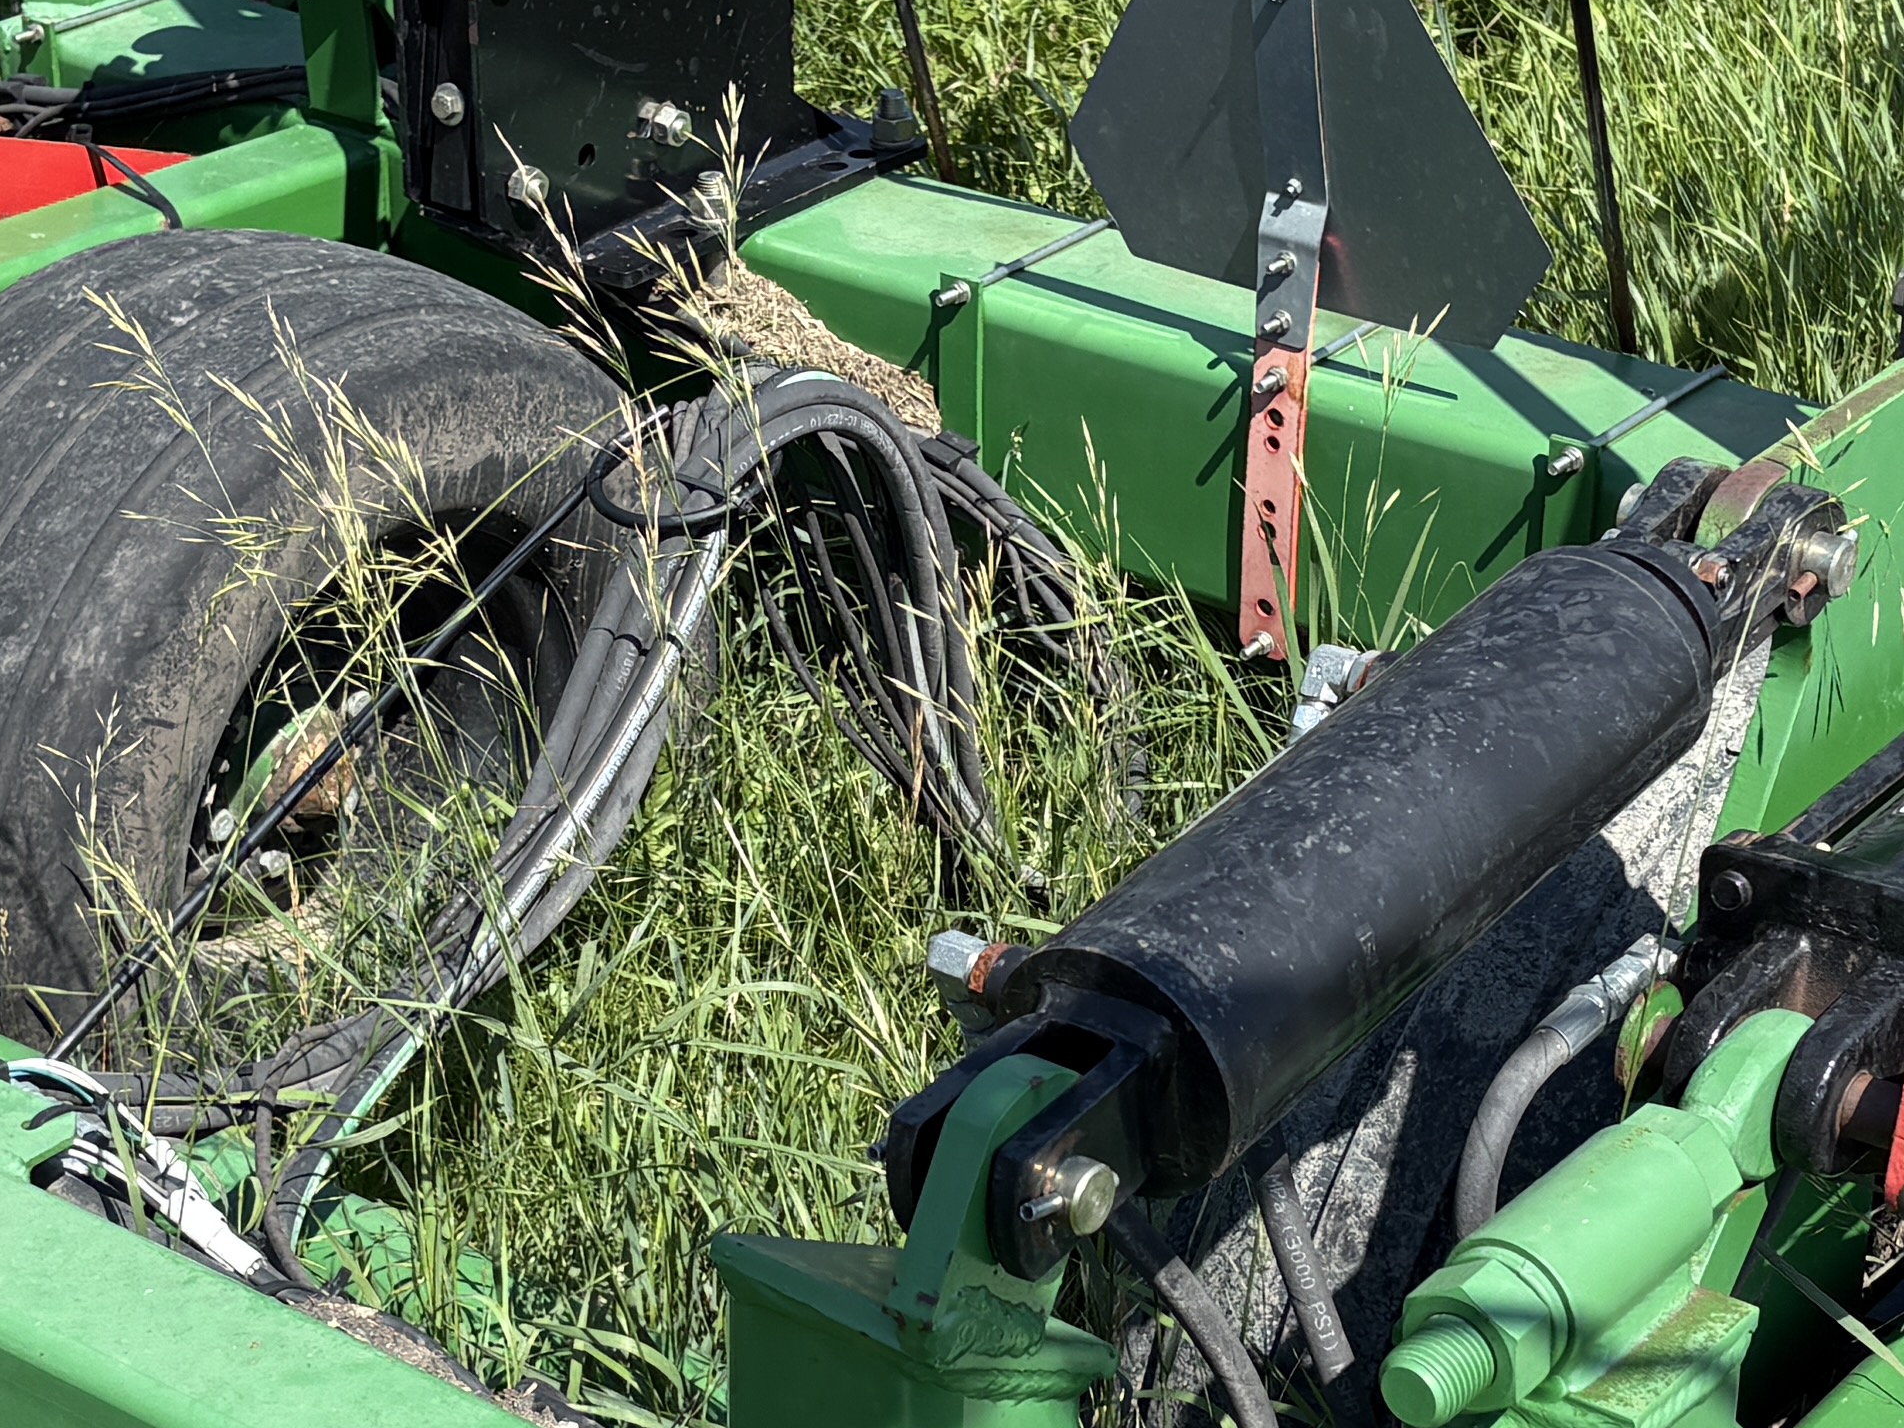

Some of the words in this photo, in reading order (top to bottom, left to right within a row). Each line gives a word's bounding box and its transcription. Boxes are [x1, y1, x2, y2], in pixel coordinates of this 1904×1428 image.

[1266, 1173, 1287, 1214] MPa
[1282, 1225, 1316, 1290] (3000
[1311, 1301, 1339, 1352] PSI)
